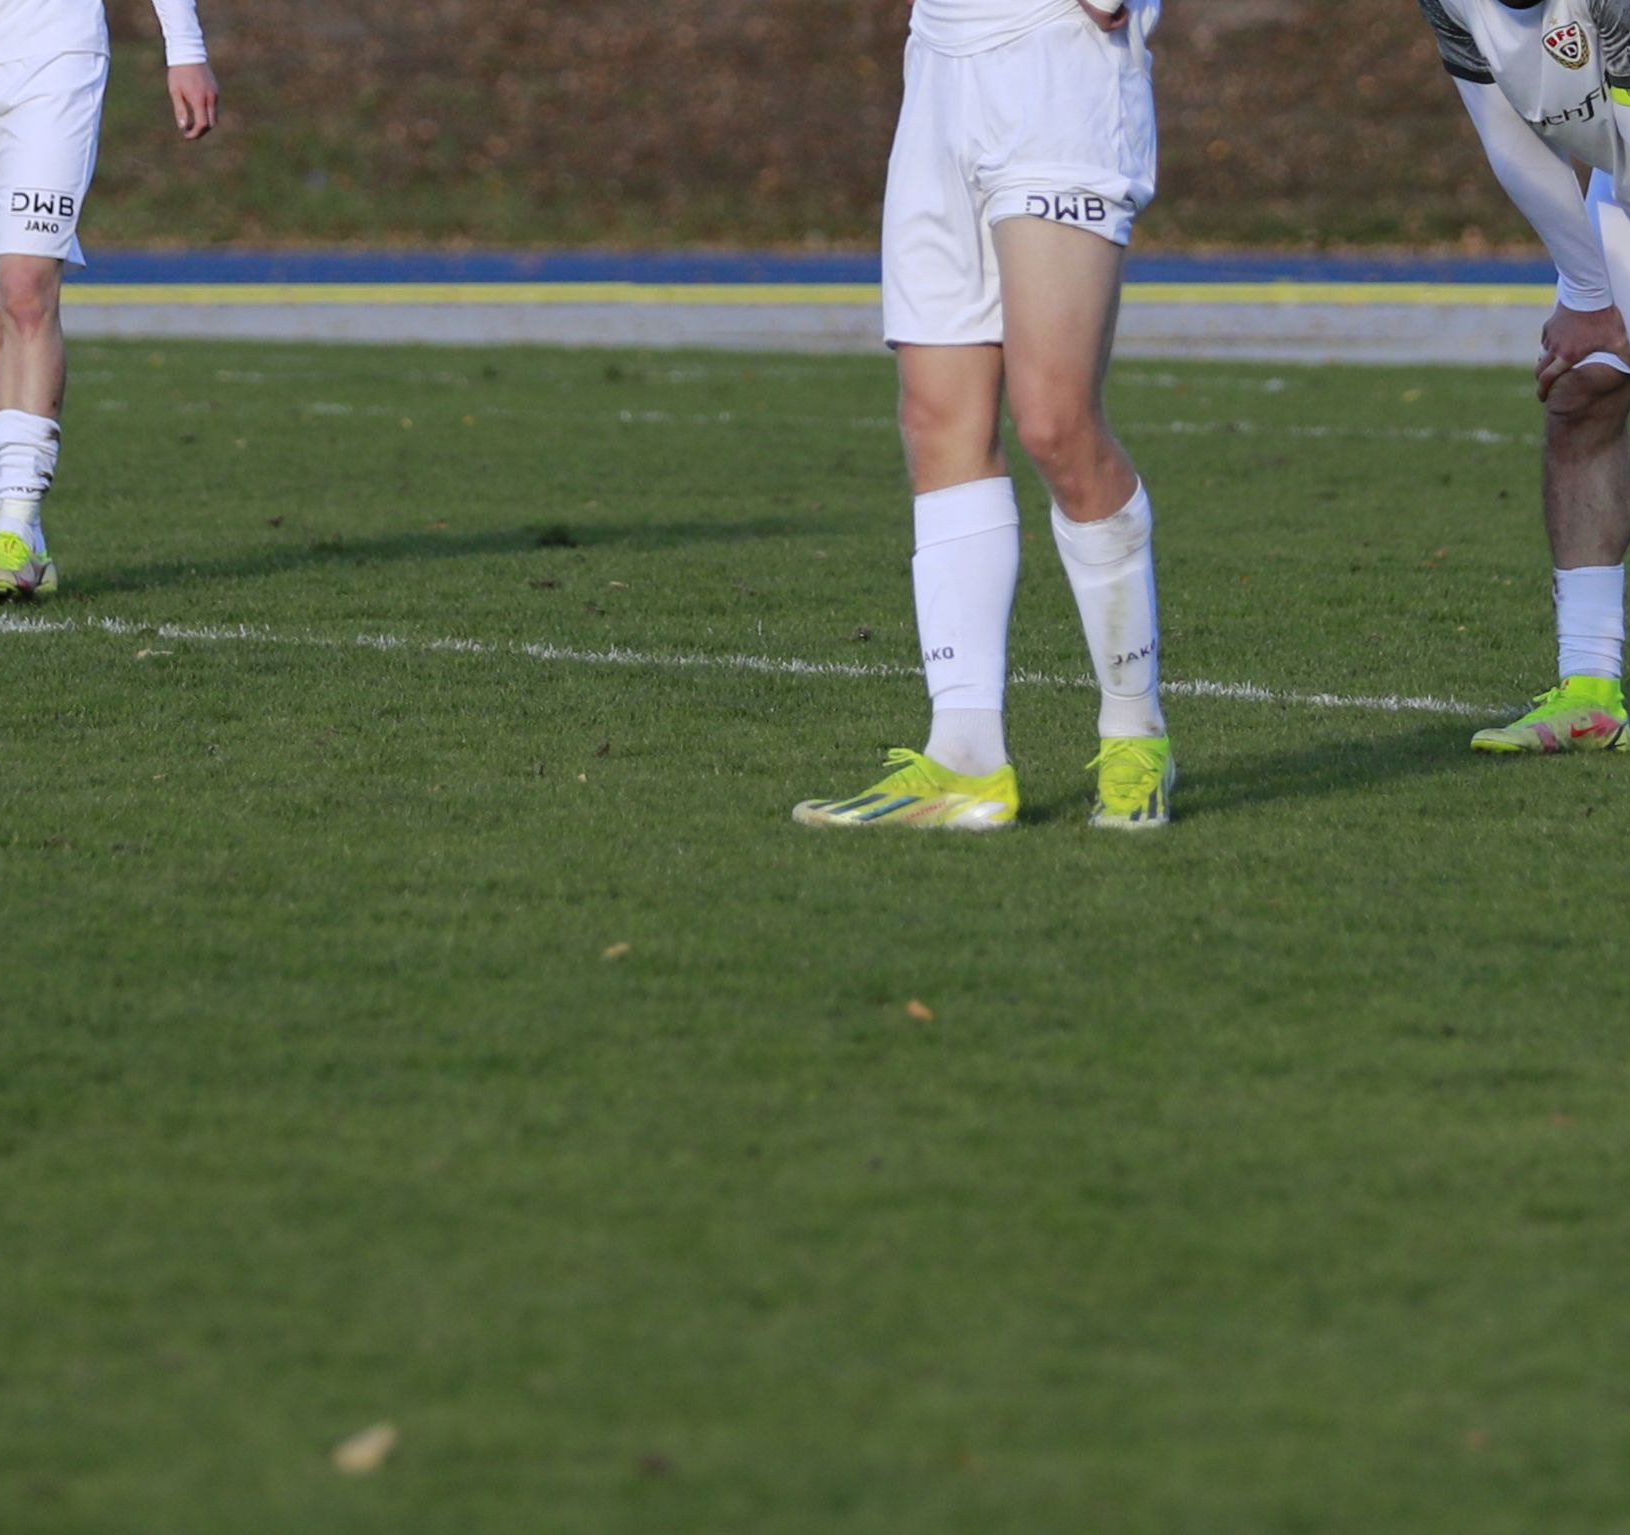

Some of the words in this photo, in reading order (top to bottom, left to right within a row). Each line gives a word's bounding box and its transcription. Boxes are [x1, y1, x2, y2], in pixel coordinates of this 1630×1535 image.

[1545, 25, 1578, 48] BFC
[24, 220, 60, 234] JAKO
[923, 646, 955, 662] AKO
